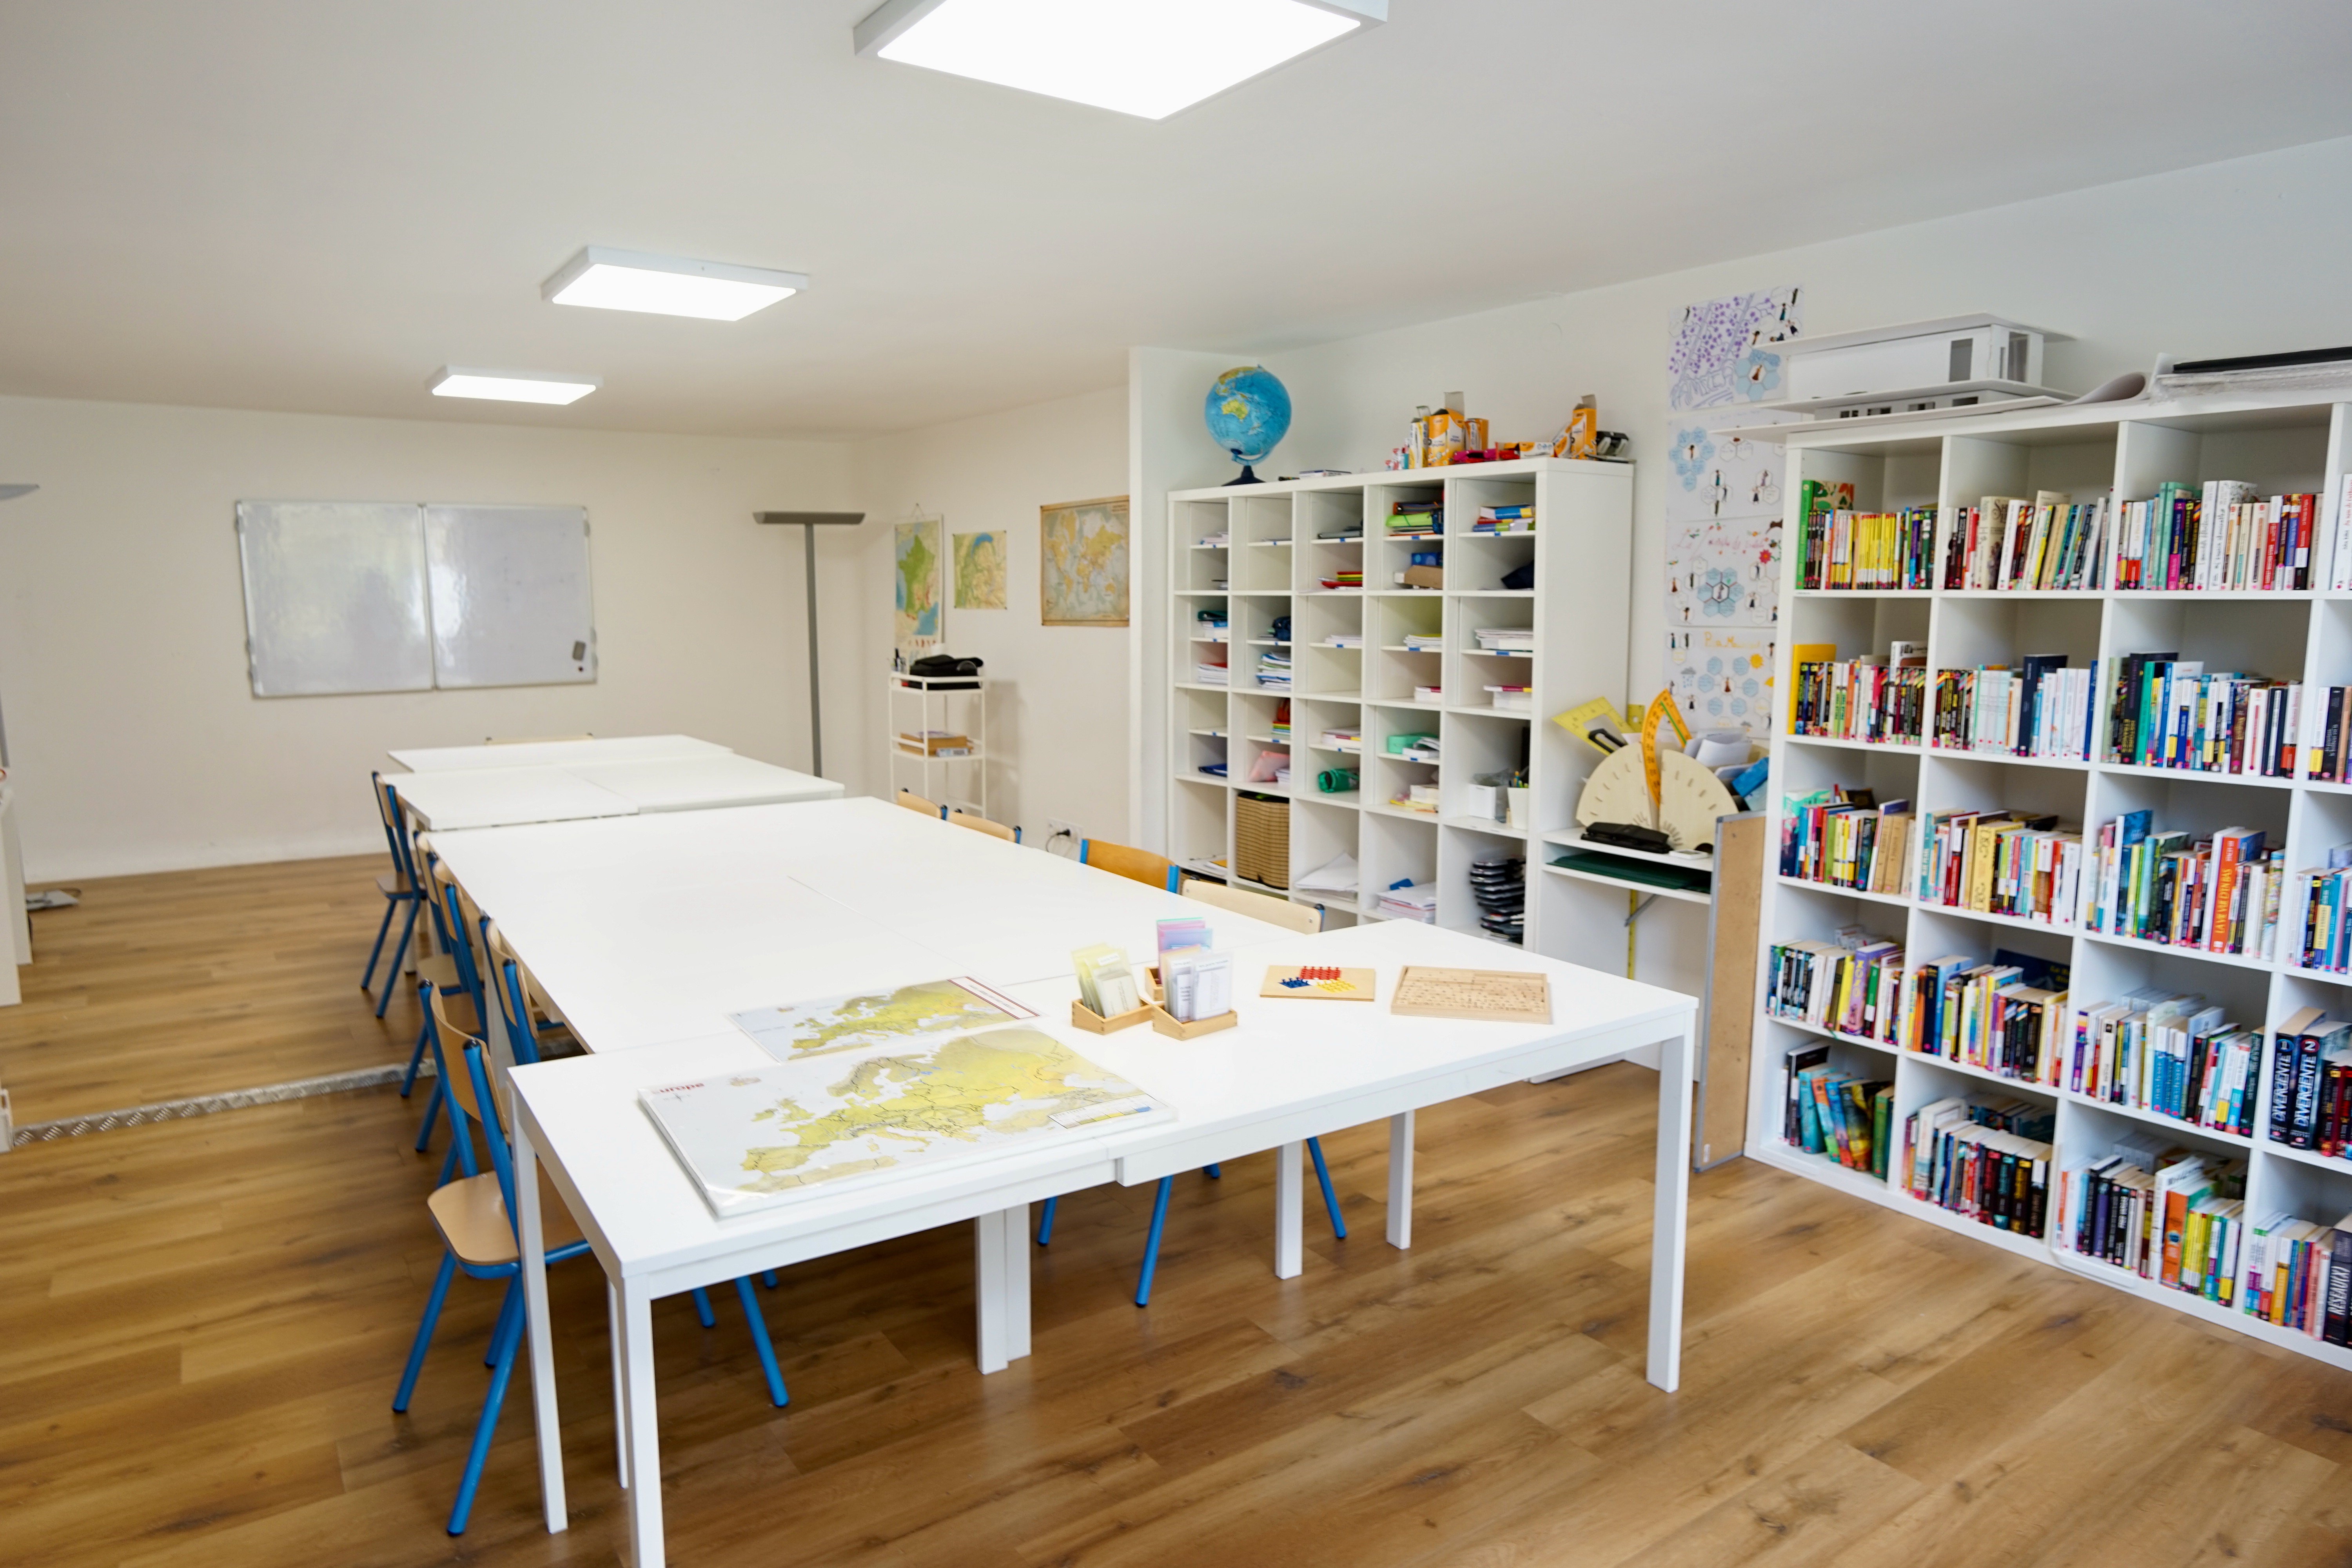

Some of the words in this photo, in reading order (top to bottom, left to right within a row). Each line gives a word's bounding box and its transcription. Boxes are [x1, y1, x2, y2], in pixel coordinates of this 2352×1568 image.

[2214, 924, 2225, 933] LA
[2305, 1040, 2316, 1051] 2
[651, 1082, 705, 1094] urope
[2272, 1053, 2291, 1122] DIVERGENTE
[2294, 1054, 2316, 1127] DIVERGENTE
